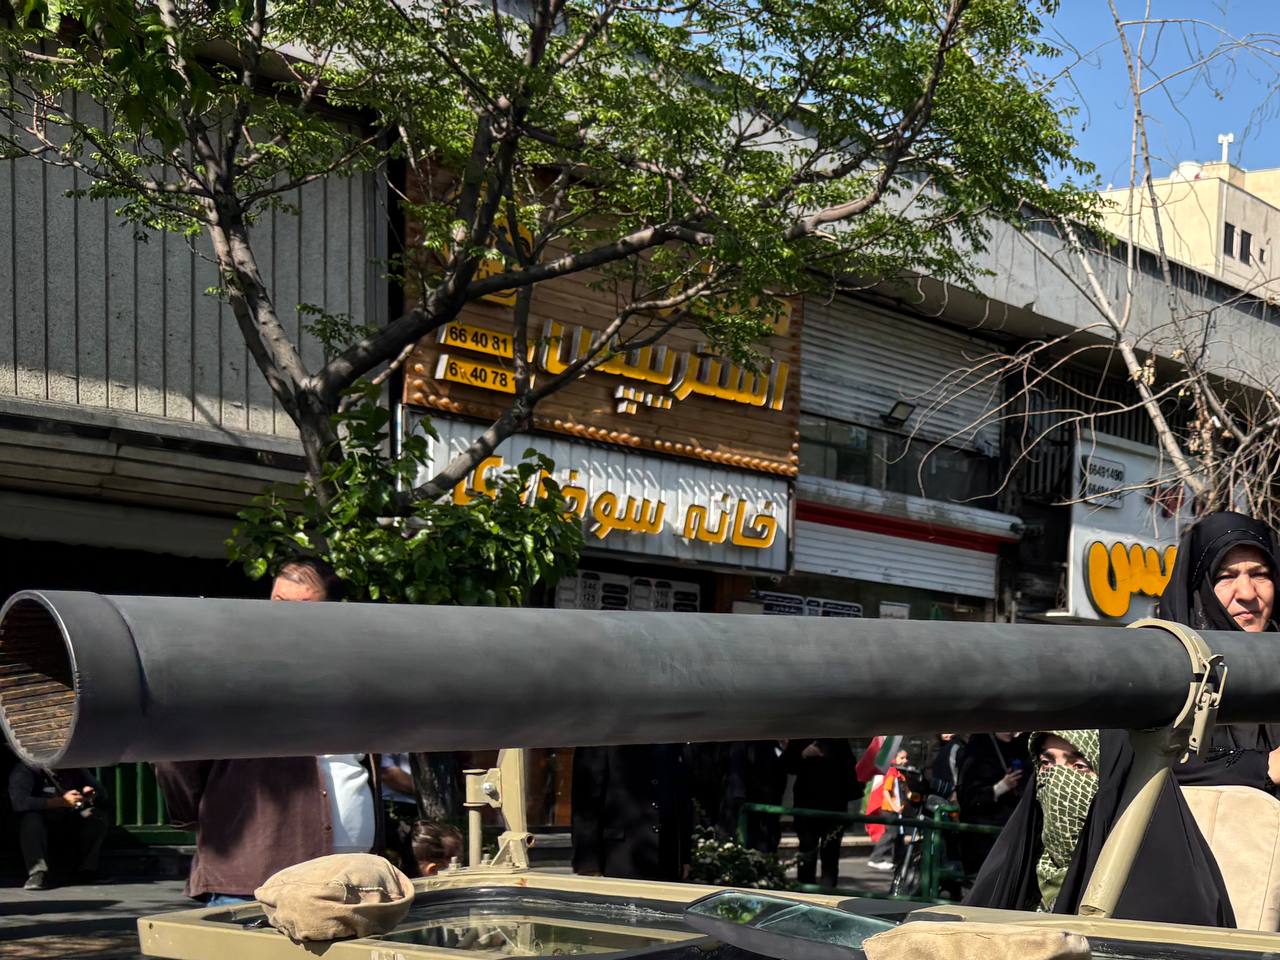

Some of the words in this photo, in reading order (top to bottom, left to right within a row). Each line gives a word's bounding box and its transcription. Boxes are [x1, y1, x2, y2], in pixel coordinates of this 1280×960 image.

[448, 325, 467, 344] 66
[471, 331, 488, 348] 40
[470, 366, 487, 383] 40
[491, 370, 508, 388] 78
[683, 492, 778, 549] خانه
